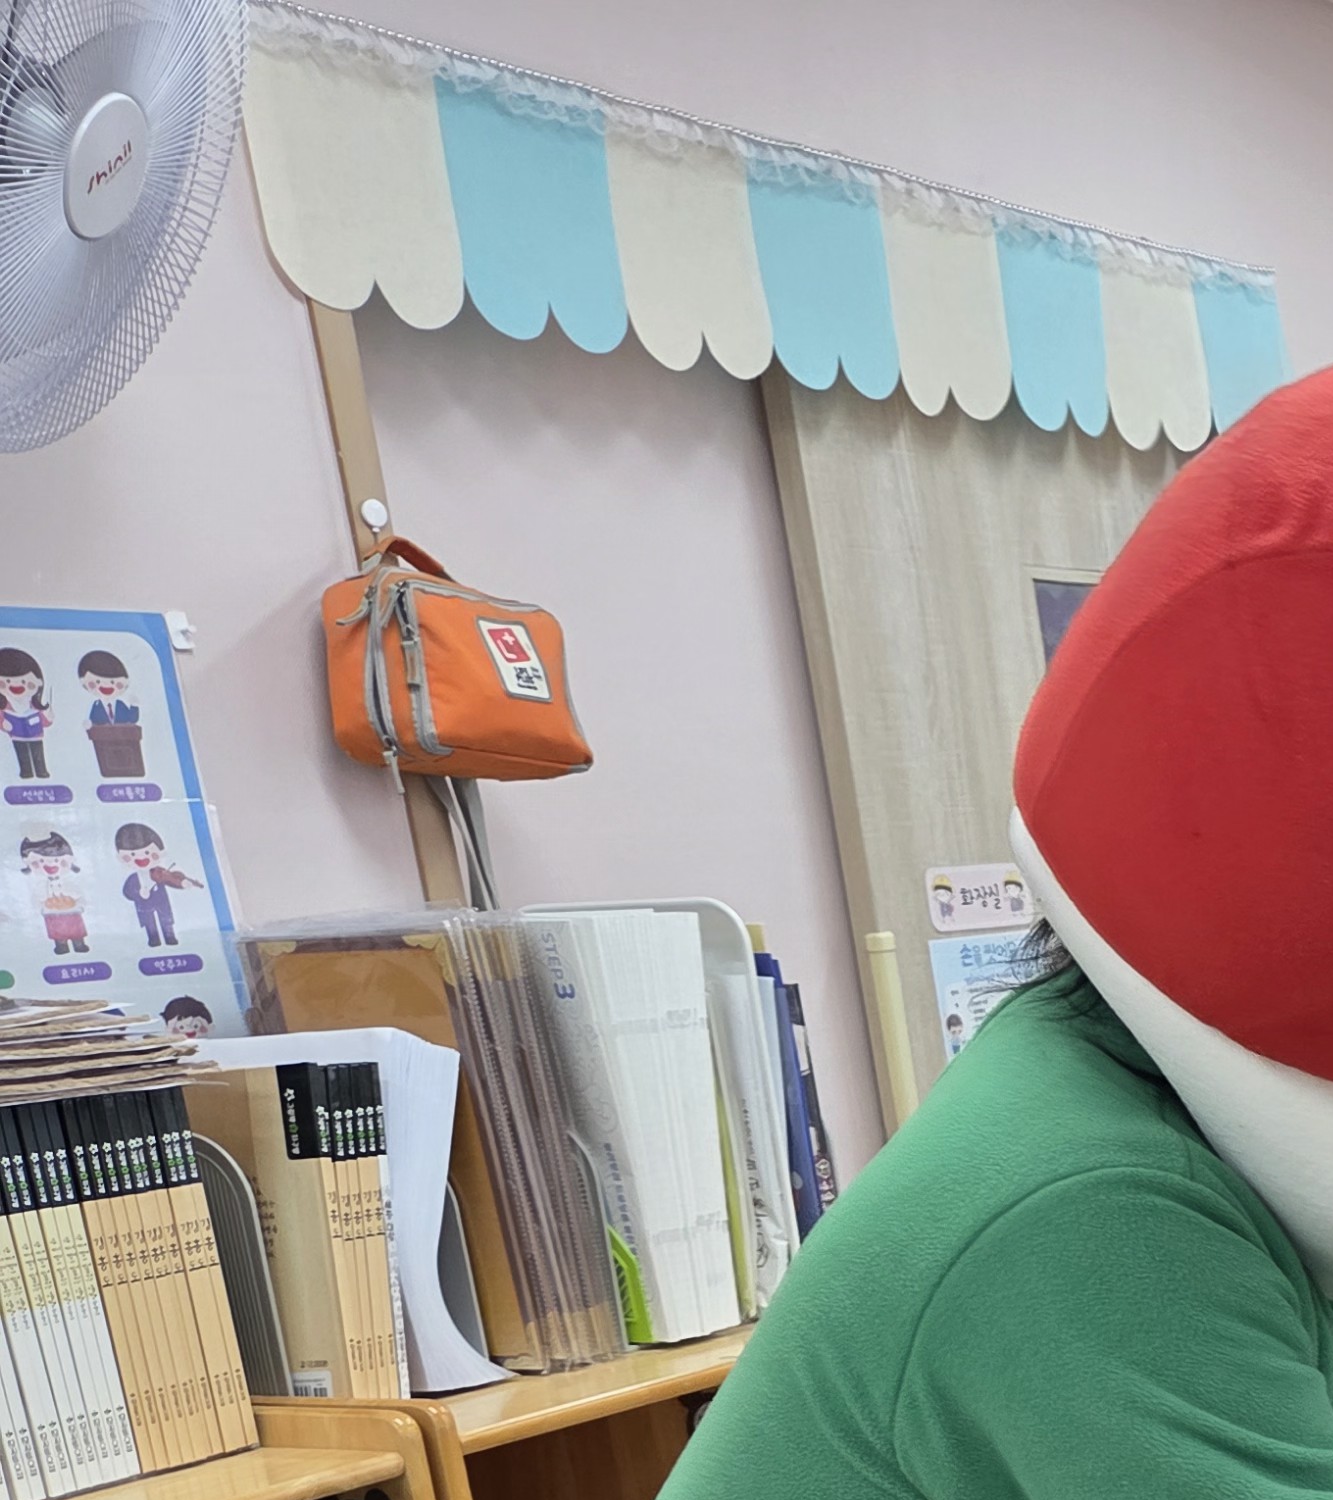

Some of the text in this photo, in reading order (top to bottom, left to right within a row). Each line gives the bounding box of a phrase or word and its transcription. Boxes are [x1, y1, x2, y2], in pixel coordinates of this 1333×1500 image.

[959, 883, 1002, 910] 화장실
[541, 931, 576, 1000] STEP 3
[94, 1236, 114, 1288] 김홍도
[108, 1233, 128, 1285] 김홍도
[122, 1231, 141, 1284] 김홍도
[135, 1229, 155, 1281] 김홍도
[200, 1217, 220, 1267] 김홍도
